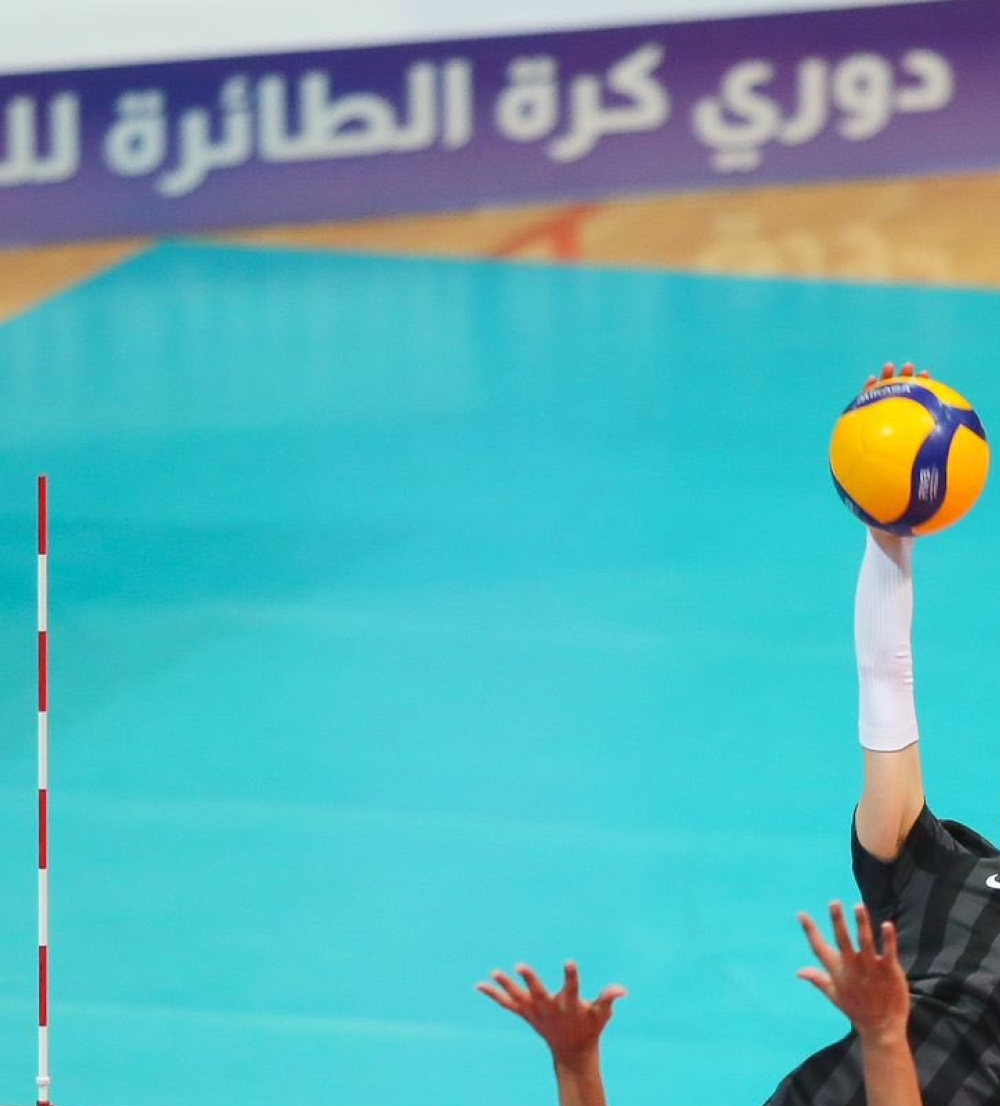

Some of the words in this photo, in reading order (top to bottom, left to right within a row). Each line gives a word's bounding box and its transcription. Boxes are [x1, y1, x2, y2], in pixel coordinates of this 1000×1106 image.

[0, 94, 80, 187] لل
[104, 60, 473, 198] الطائرة
[495, 43, 671, 164] كرة
[690, 47, 956, 174] دوري
